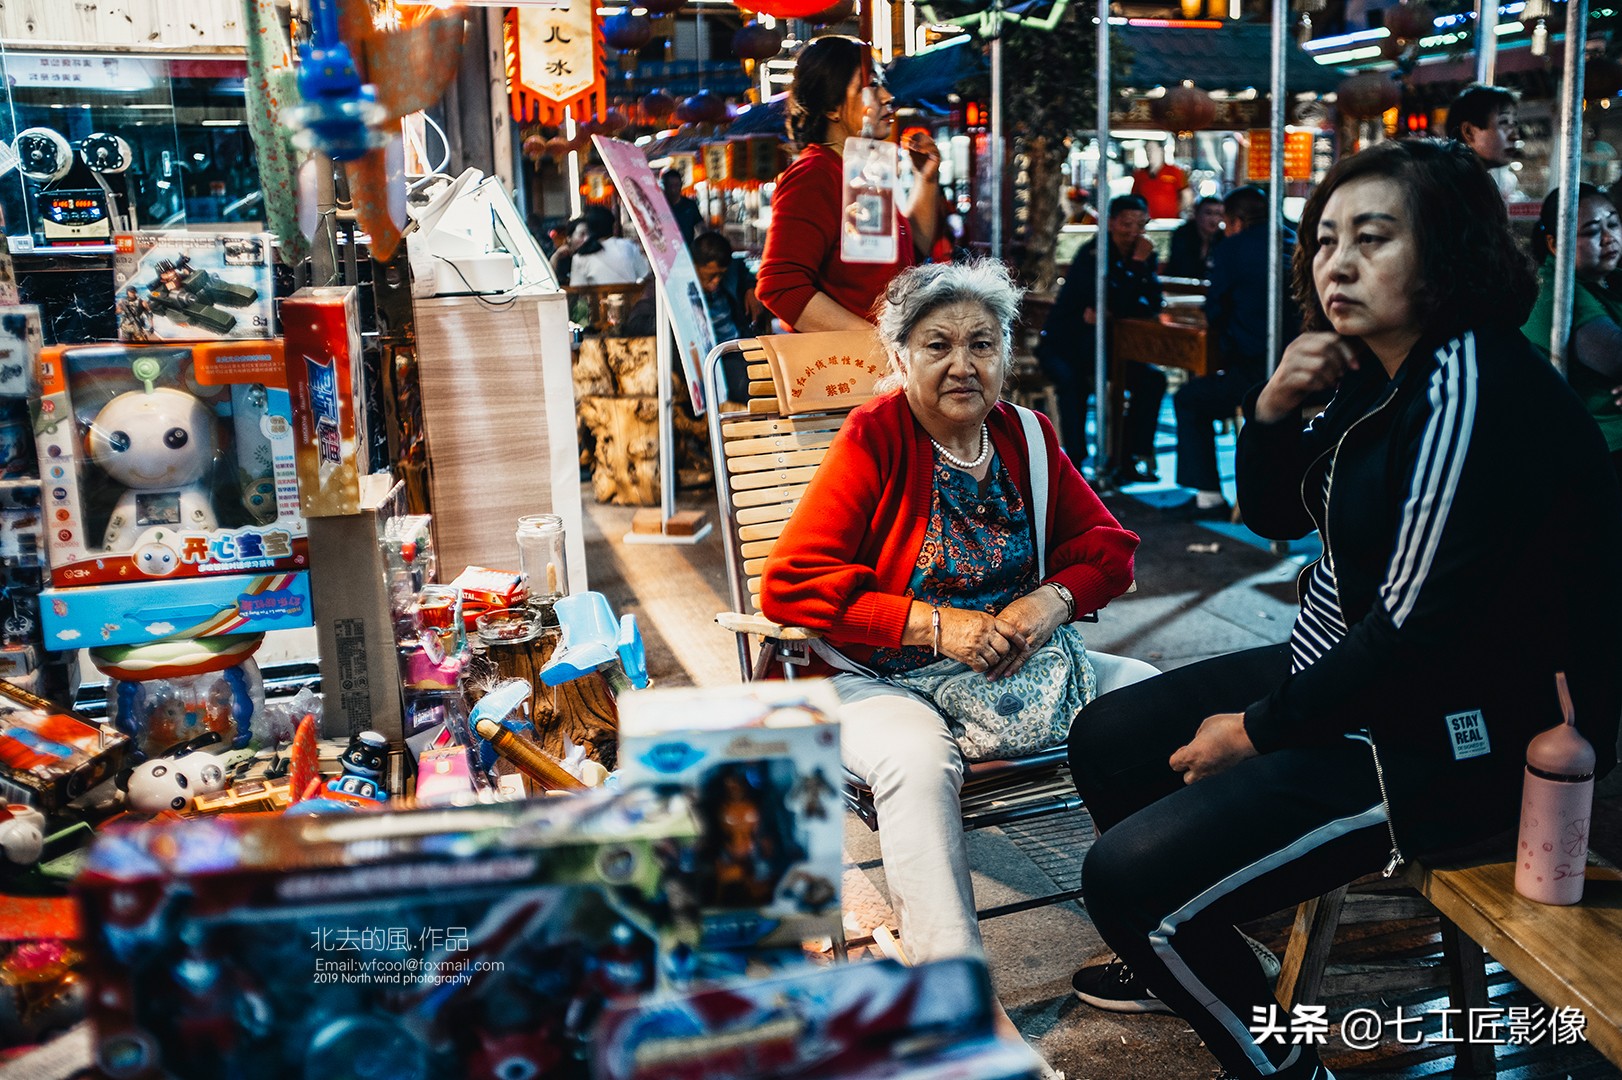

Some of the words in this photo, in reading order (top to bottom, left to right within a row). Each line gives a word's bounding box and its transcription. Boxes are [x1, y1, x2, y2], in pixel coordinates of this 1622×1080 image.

[543, 8, 572, 76] 儿冰
[157, 236, 215, 249] DEFENSE
[182, 531, 291, 560] 开心宝宝
[1451, 714, 1479, 731] STAY
[1455, 728, 1484, 745] REAL
